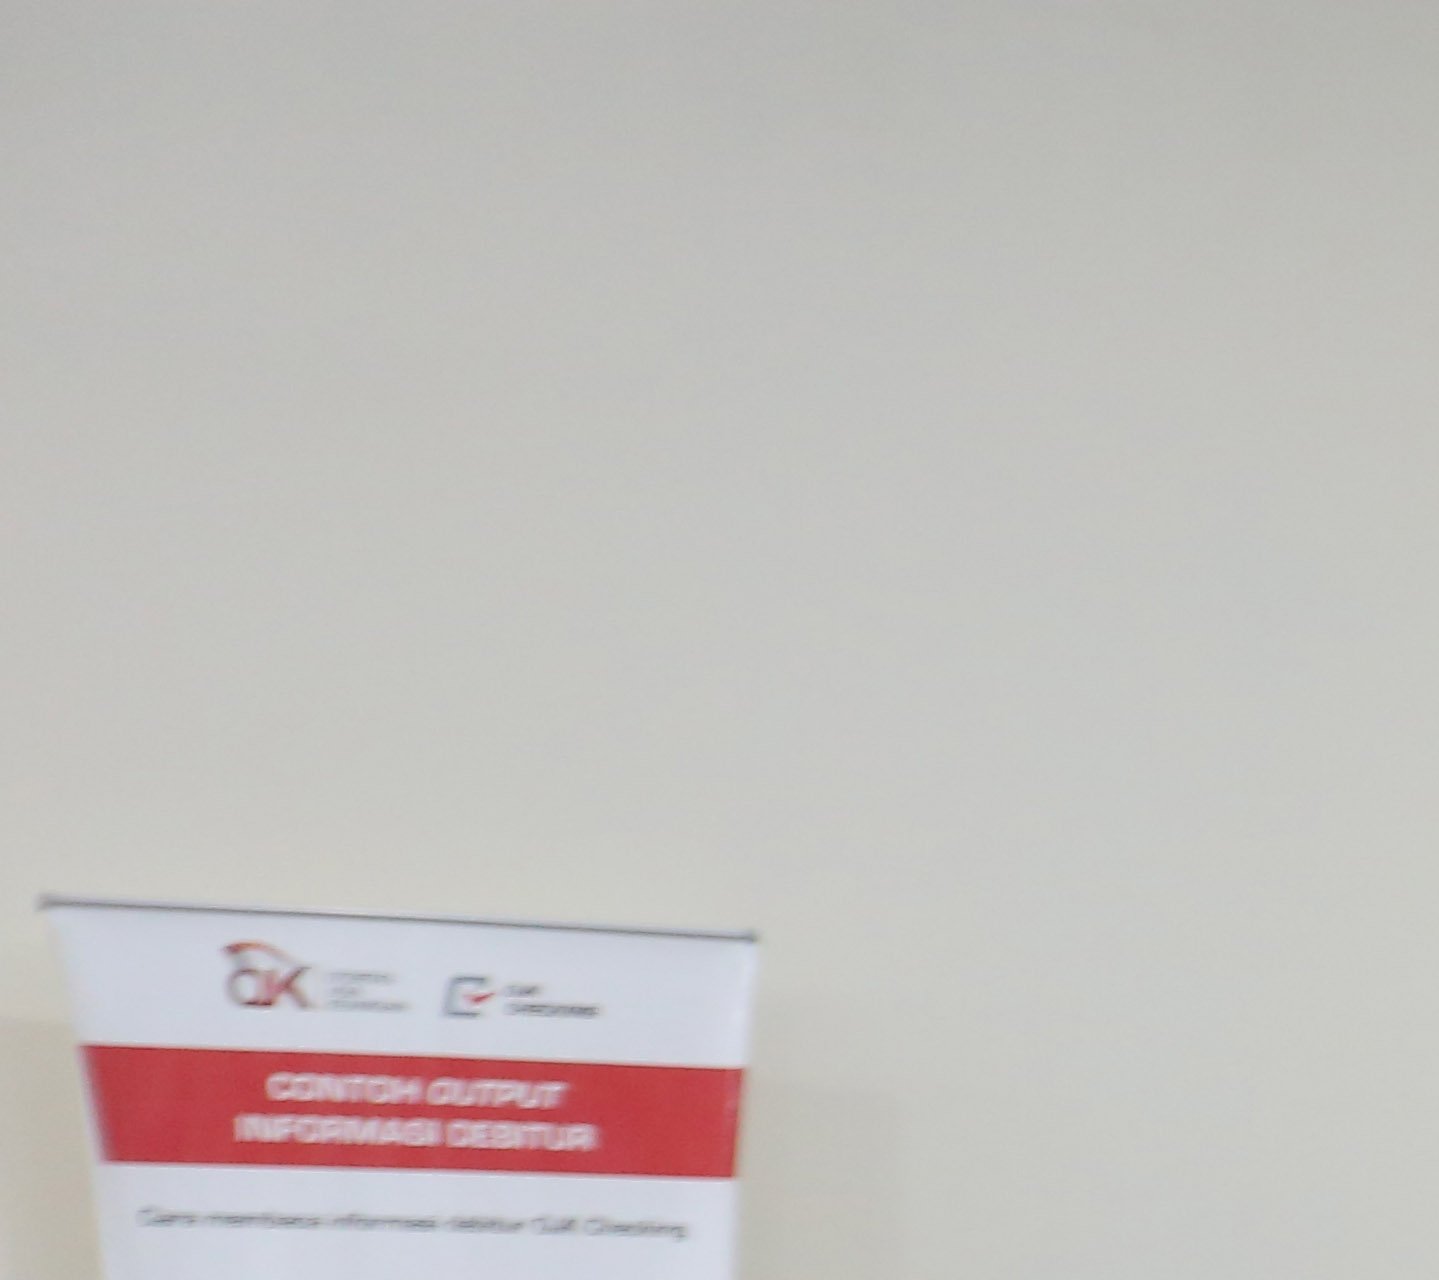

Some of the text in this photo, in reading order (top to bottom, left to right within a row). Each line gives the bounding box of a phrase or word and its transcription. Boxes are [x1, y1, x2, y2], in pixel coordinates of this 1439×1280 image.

[264, 1070, 570, 1110] CONTOH OUTPUT
[233, 1112, 600, 1151] INFORMASI DEBITUR
